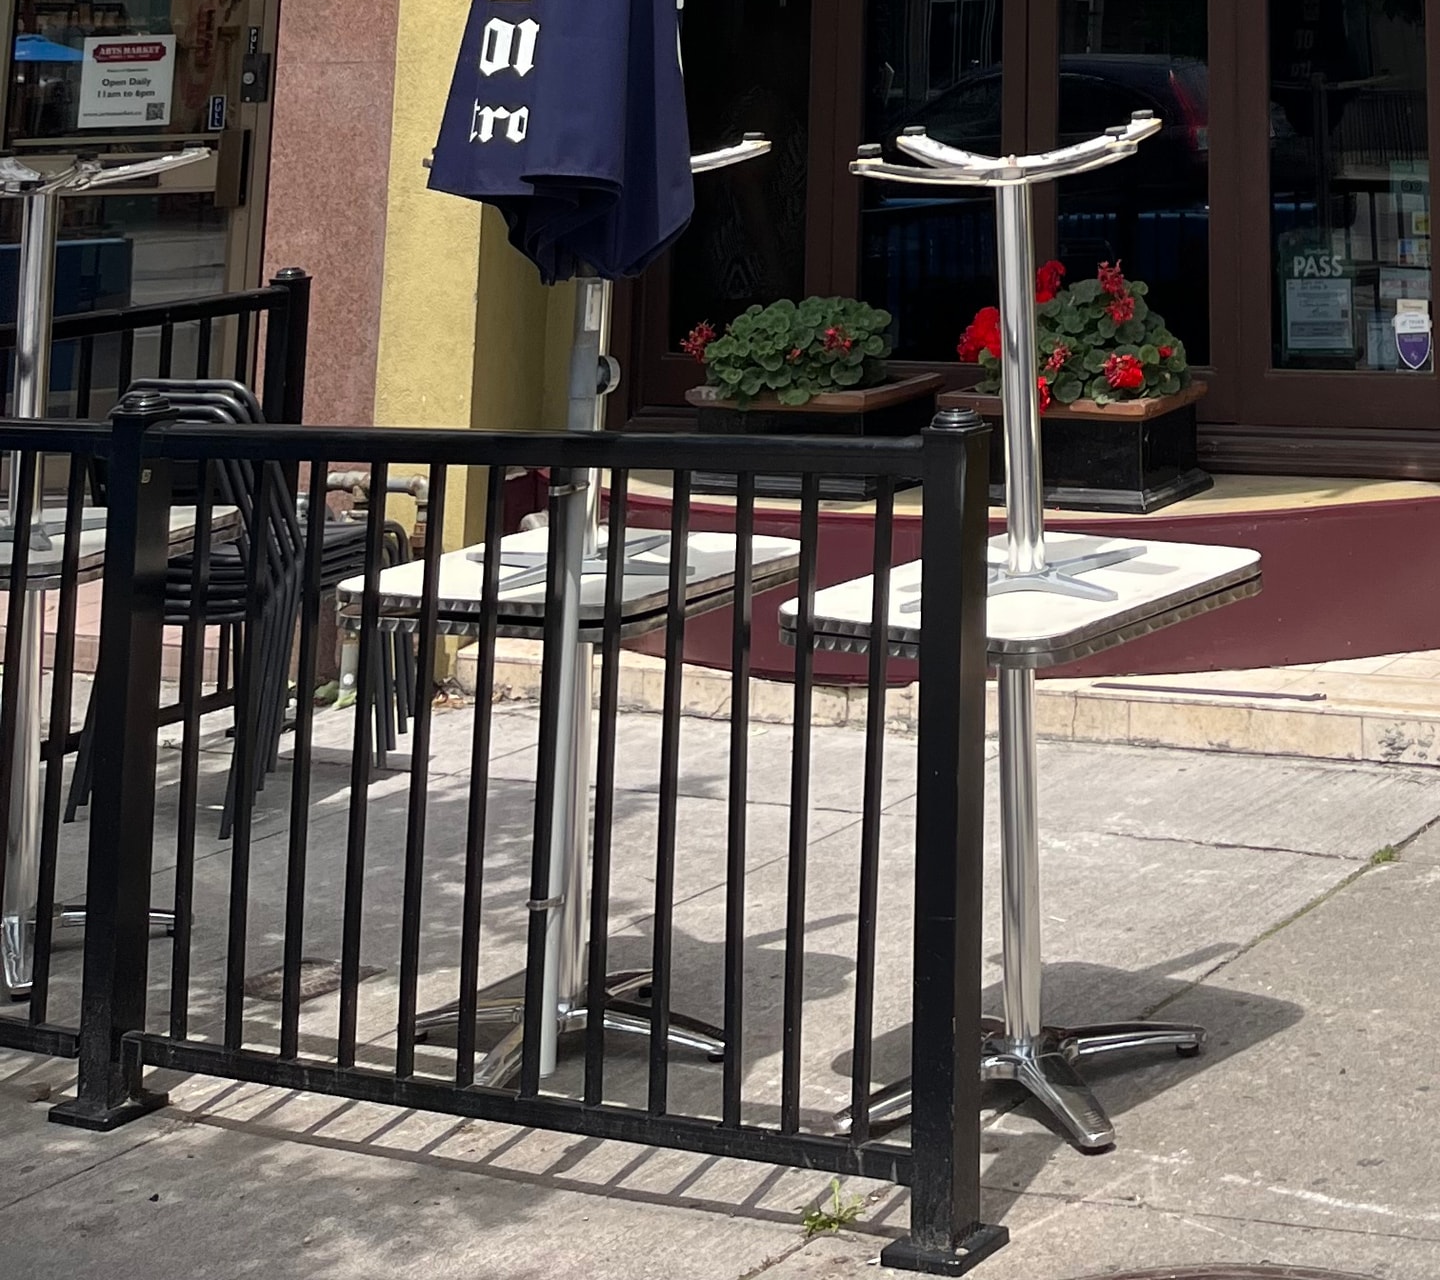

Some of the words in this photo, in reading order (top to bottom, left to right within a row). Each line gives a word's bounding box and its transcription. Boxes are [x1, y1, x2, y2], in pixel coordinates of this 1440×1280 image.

[123, 45, 161, 55] MARKET
[101, 78, 127, 88] Open
[129, 77, 152, 88] Daily
[214, 98, 223, 127] PULL
[1293, 255, 1344, 278] PASS
